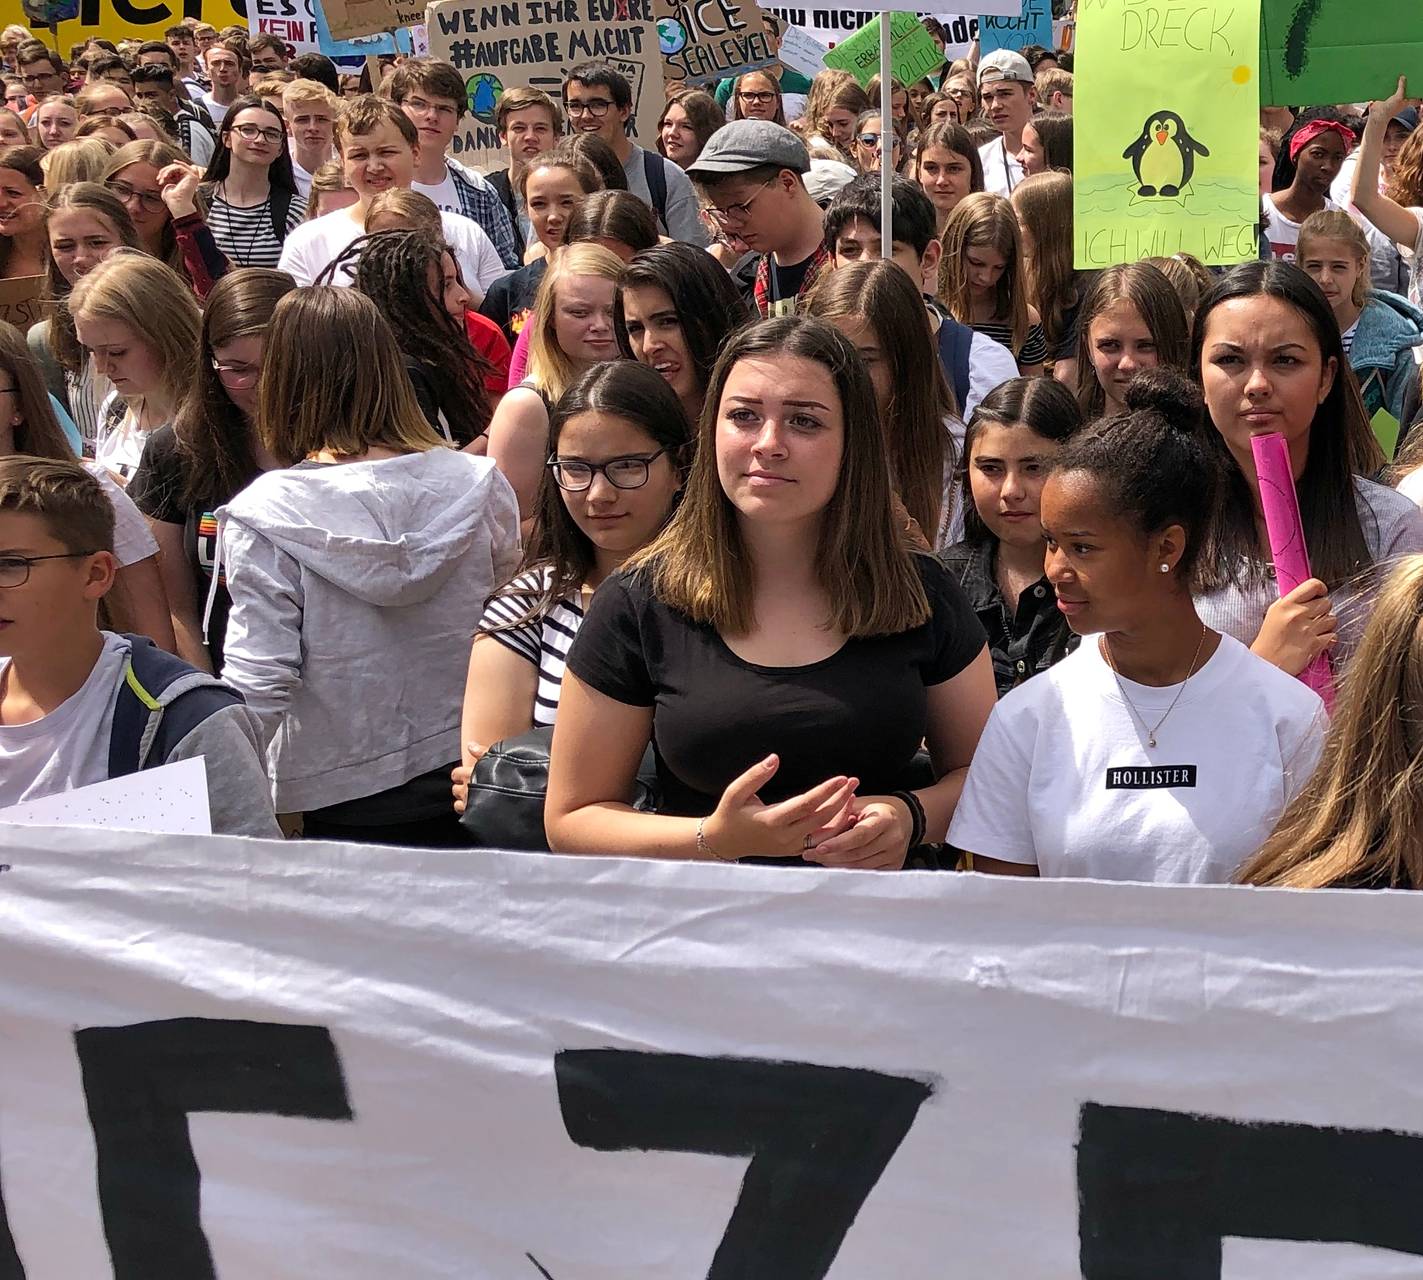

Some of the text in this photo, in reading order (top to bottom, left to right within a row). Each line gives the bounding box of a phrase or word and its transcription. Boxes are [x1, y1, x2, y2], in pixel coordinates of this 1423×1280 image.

[259, 18, 305, 42] KEIN
[437, 2, 521, 36] WENN
[526, 0, 581, 25] IHR
[1120, 7, 1235, 57] DRECK,
[449, 26, 645, 69] #AUFGABE MACHT
[1084, 228, 1128, 264] ICH
[1112, 769, 1190, 785] HOLLISTER
